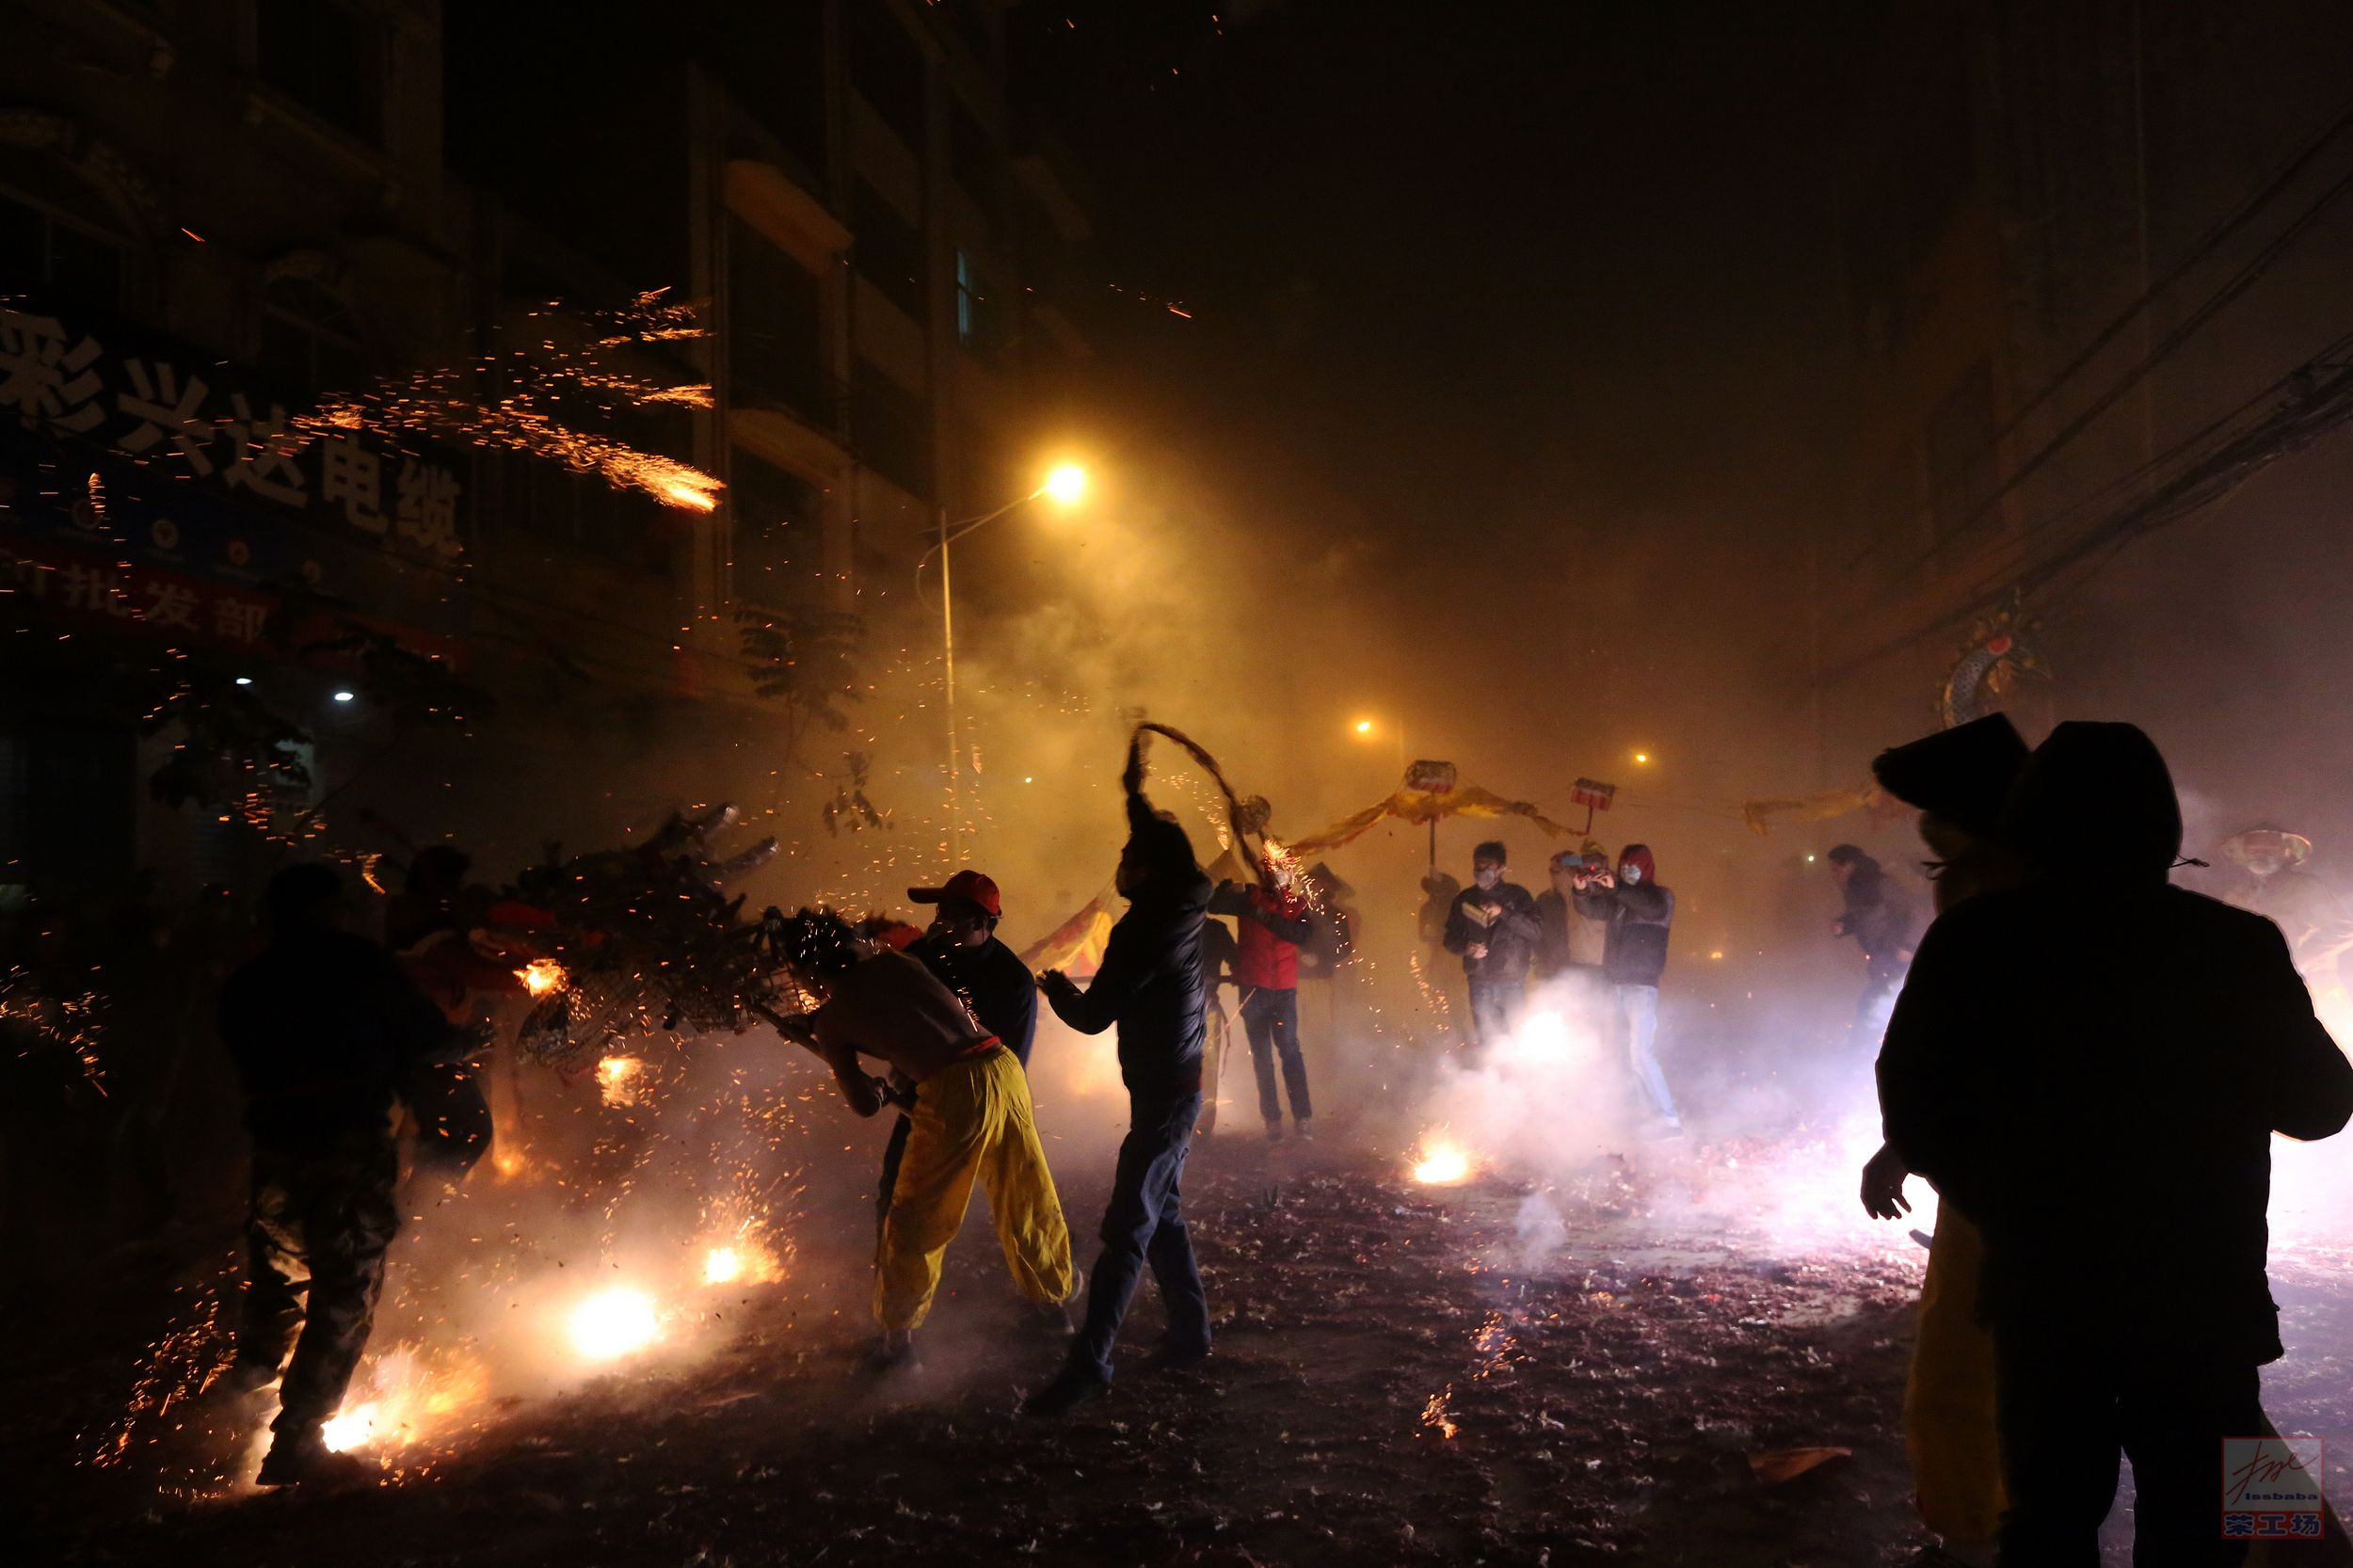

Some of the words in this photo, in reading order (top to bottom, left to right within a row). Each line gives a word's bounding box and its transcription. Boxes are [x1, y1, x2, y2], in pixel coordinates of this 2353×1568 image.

[0, 308, 463, 557] 彩兴达电缆
